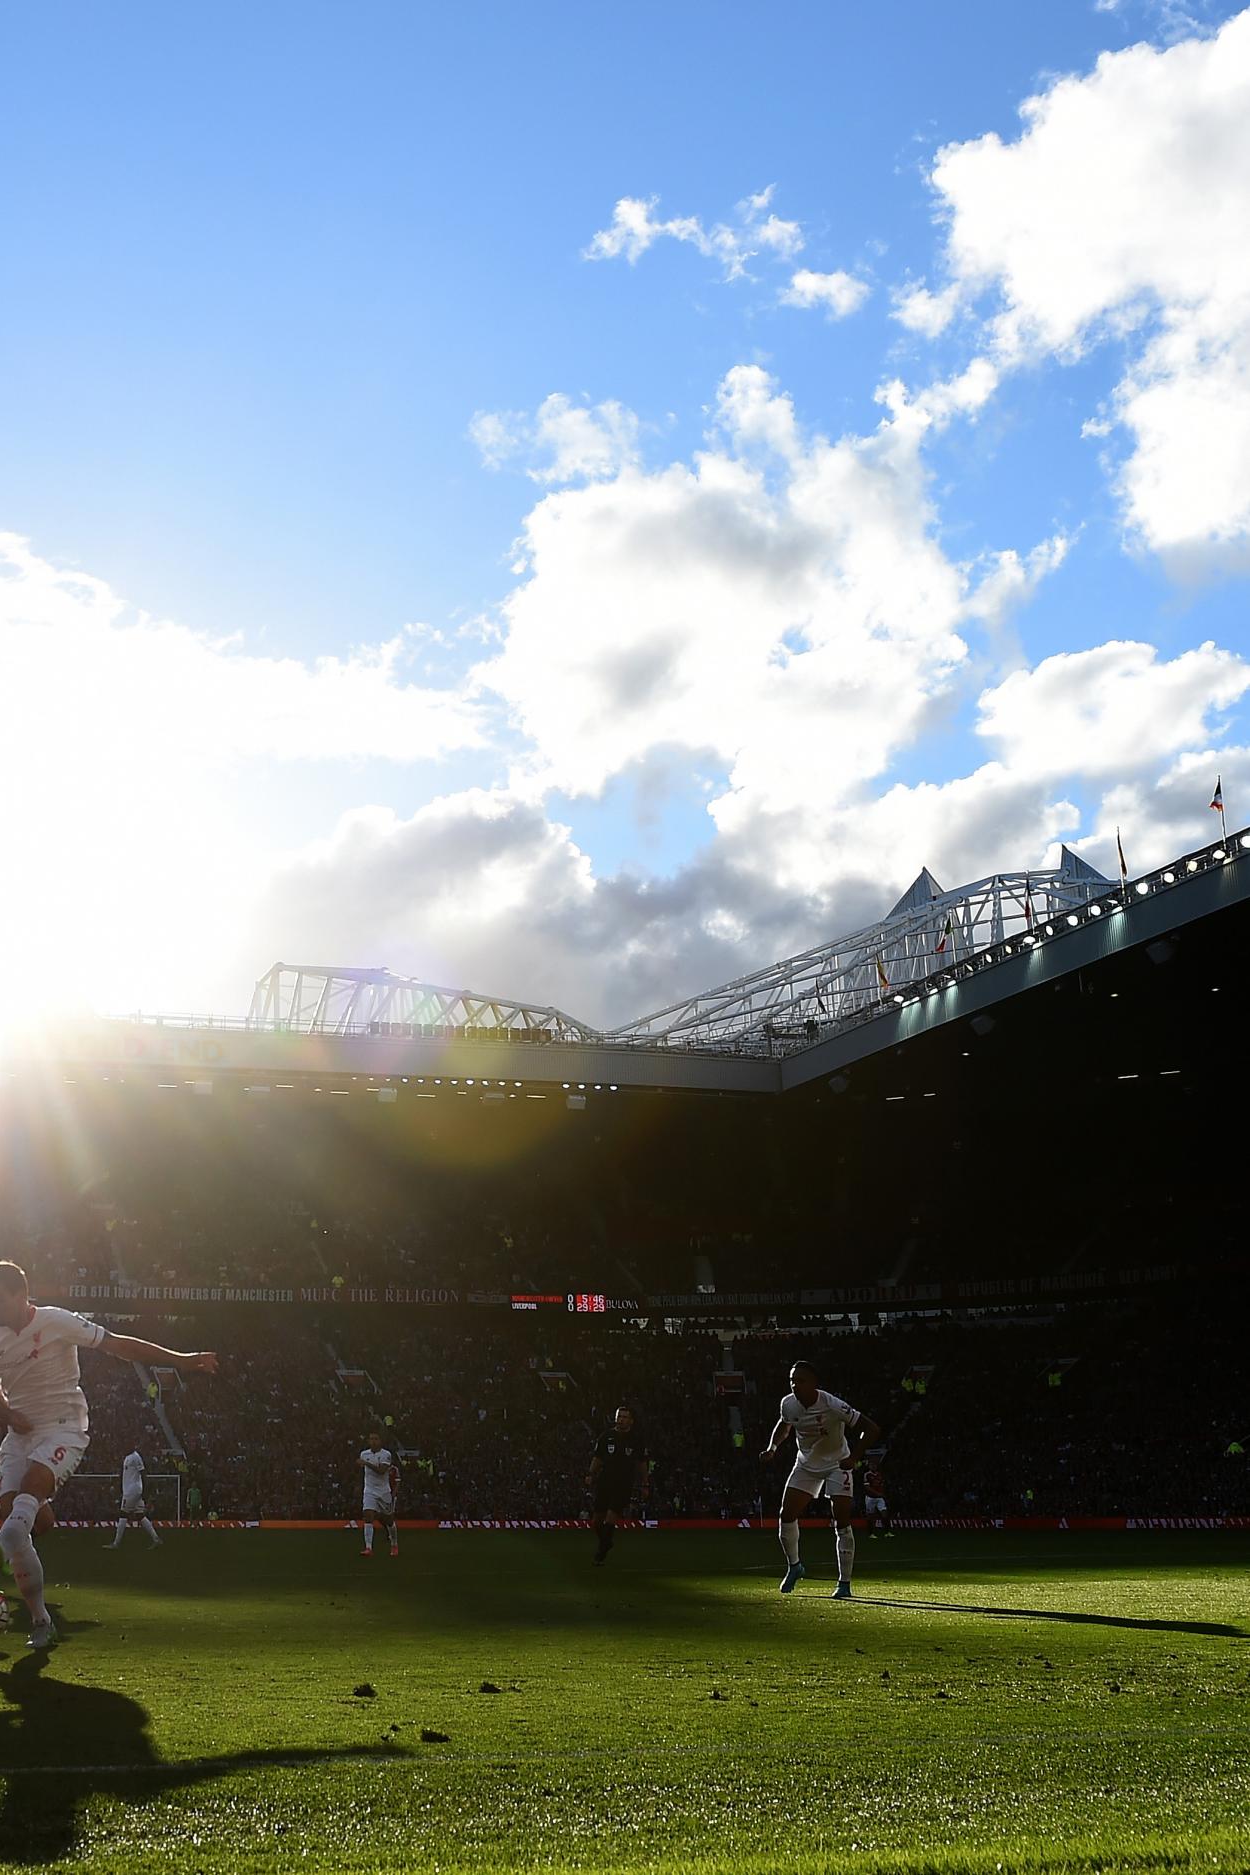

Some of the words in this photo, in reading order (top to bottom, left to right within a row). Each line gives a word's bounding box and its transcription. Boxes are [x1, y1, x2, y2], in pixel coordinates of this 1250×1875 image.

[143, 1287, 161, 1300] THE
[163, 1288, 209, 1301] FLOWERS
[210, 1289, 223, 1301] OF
[225, 1288, 293, 1303] MANCHESTER
[300, 1287, 341, 1303] MUFC
[349, 1288, 378, 1303] THE
[385, 1287, 462, 1304] RELIGION
[54, 1447, 67, 1462] 6
[842, 1471, 851, 1486] 2
